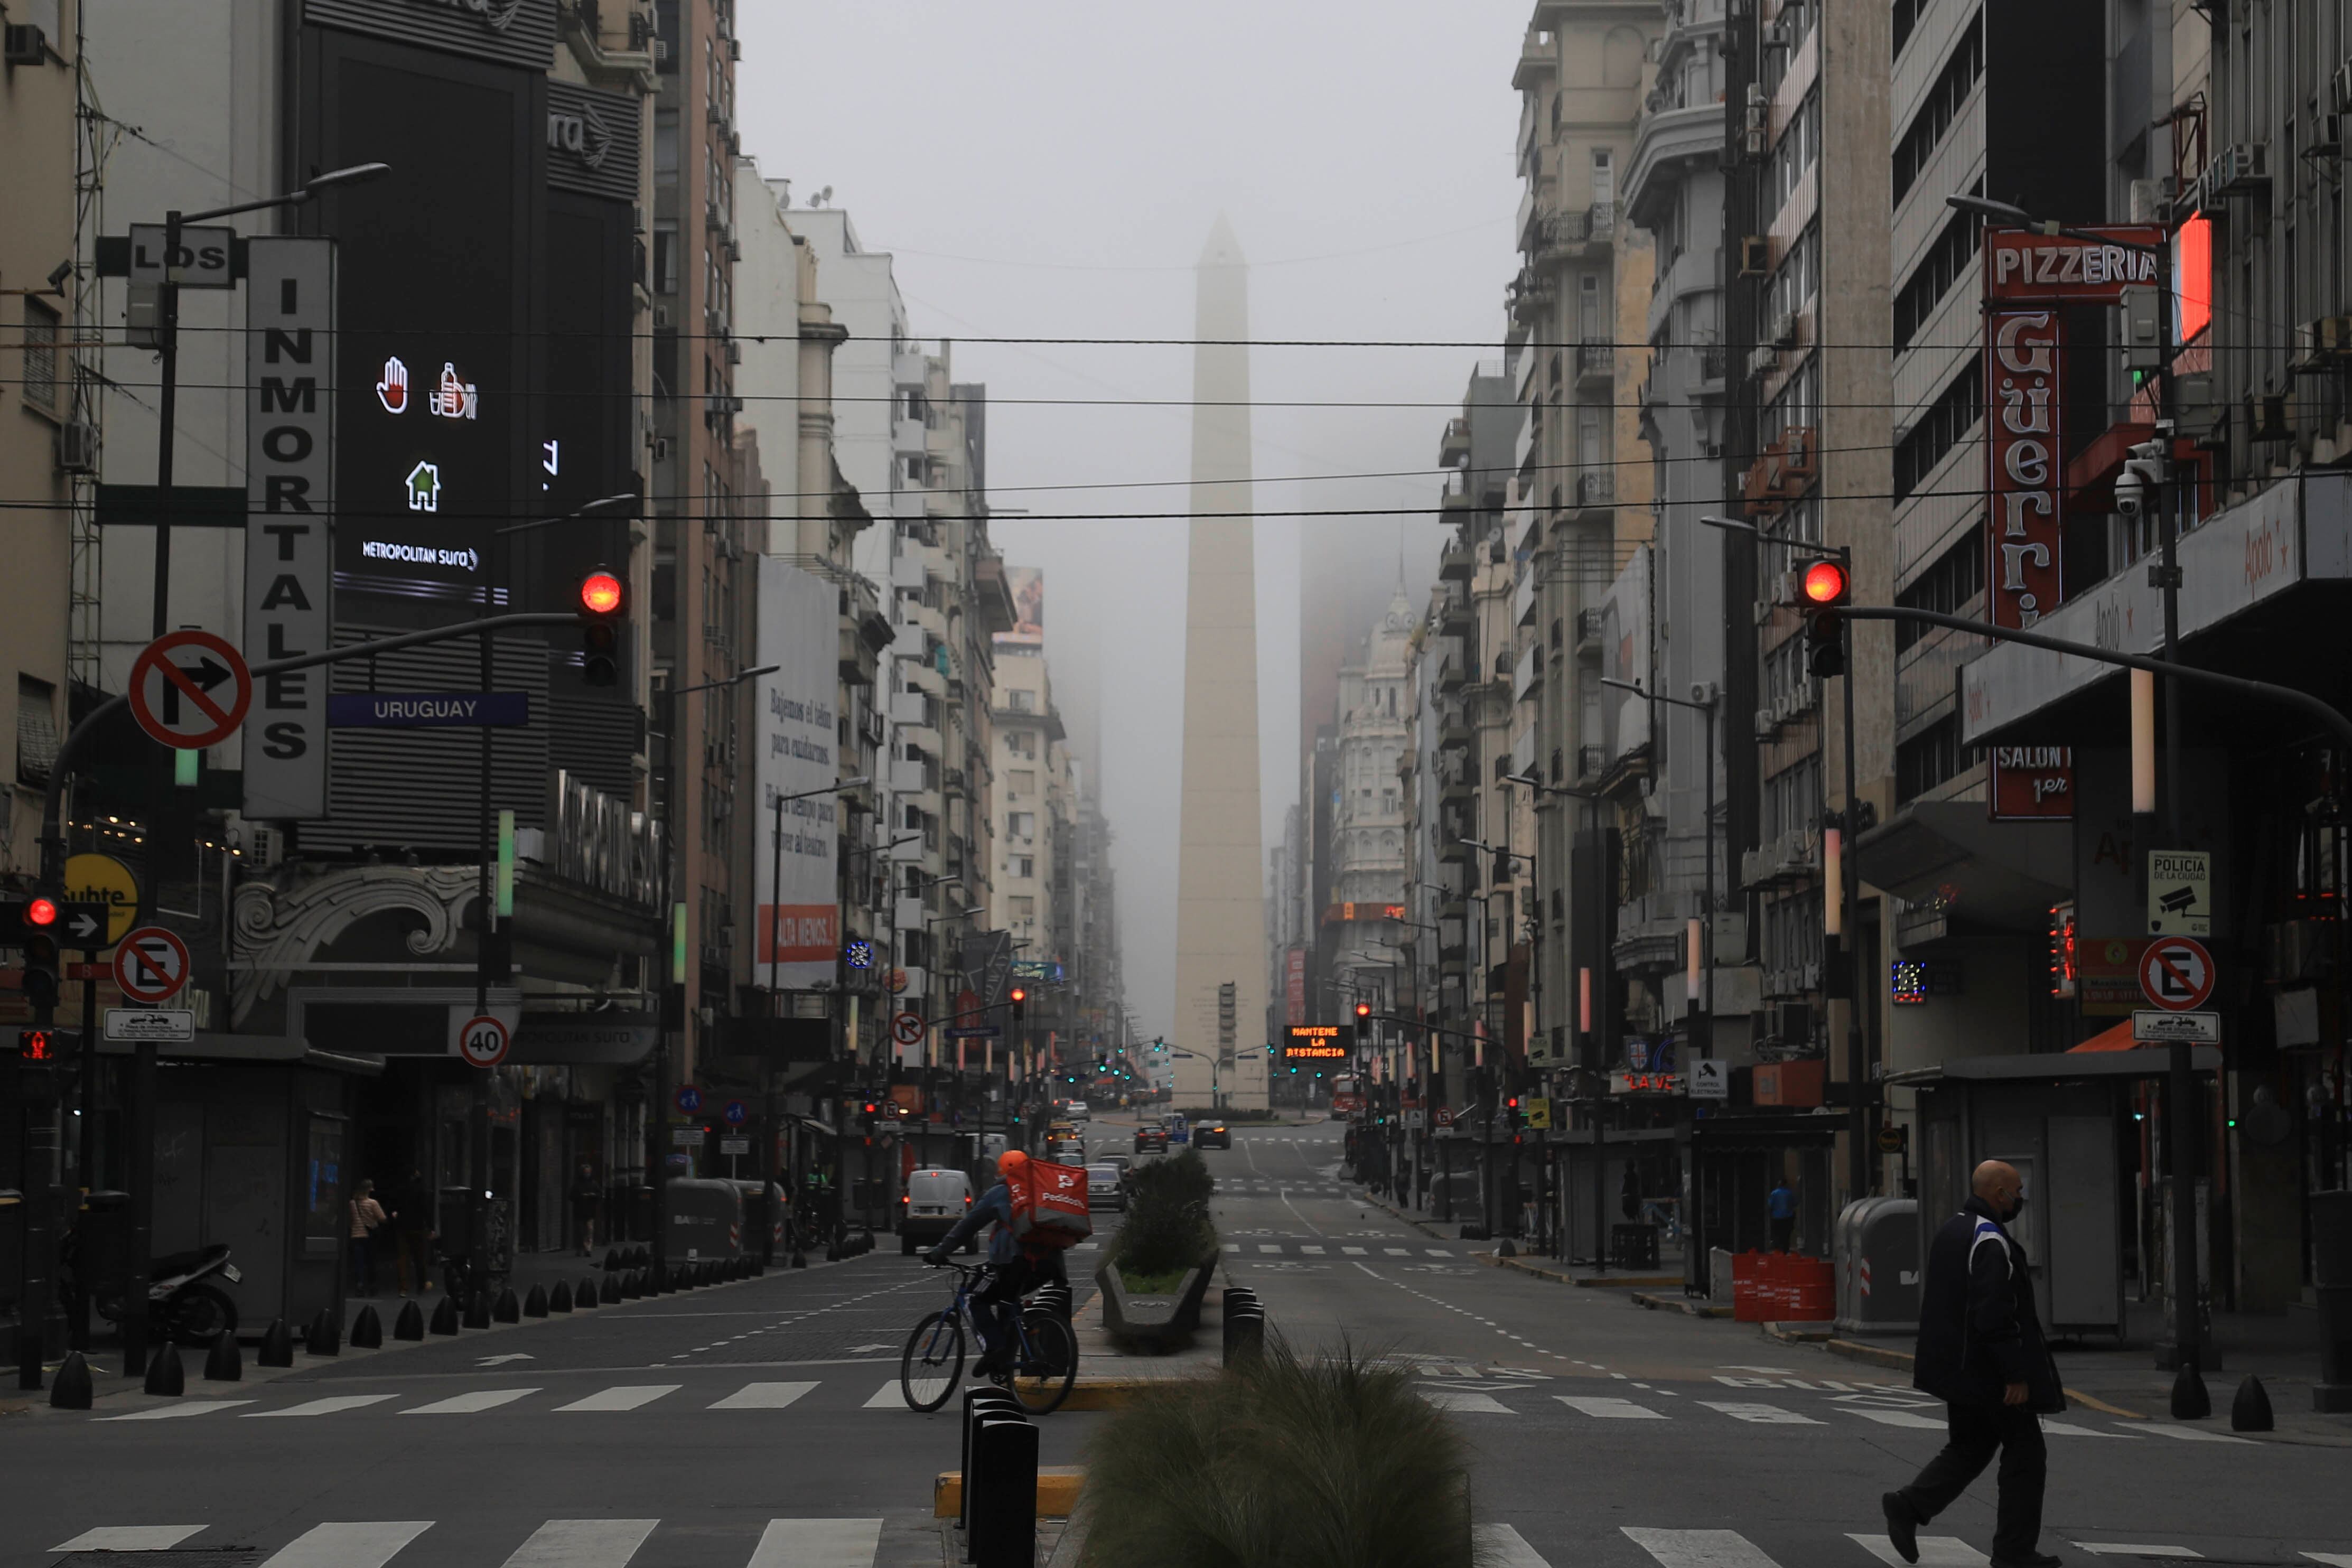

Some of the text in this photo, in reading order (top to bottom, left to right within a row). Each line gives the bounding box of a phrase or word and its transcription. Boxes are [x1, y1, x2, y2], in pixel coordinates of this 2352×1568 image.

[135, 245, 226, 269] LOS
[1996, 245, 2159, 285] PIZZERIA
[260, 278, 316, 760] INMORTALES
[362, 540, 469, 567] METROPOLITAN sura
[2245, 515, 2272, 600] Apolo
[374, 700, 477, 718] URUGUAY
[771, 687, 804, 723] Bajemos
[772, 733, 789, 759] para
[2154, 859, 2205, 872] POLICIA
[470, 1031, 498, 1052] 40
[1311, 1037, 1326, 1047] LA
